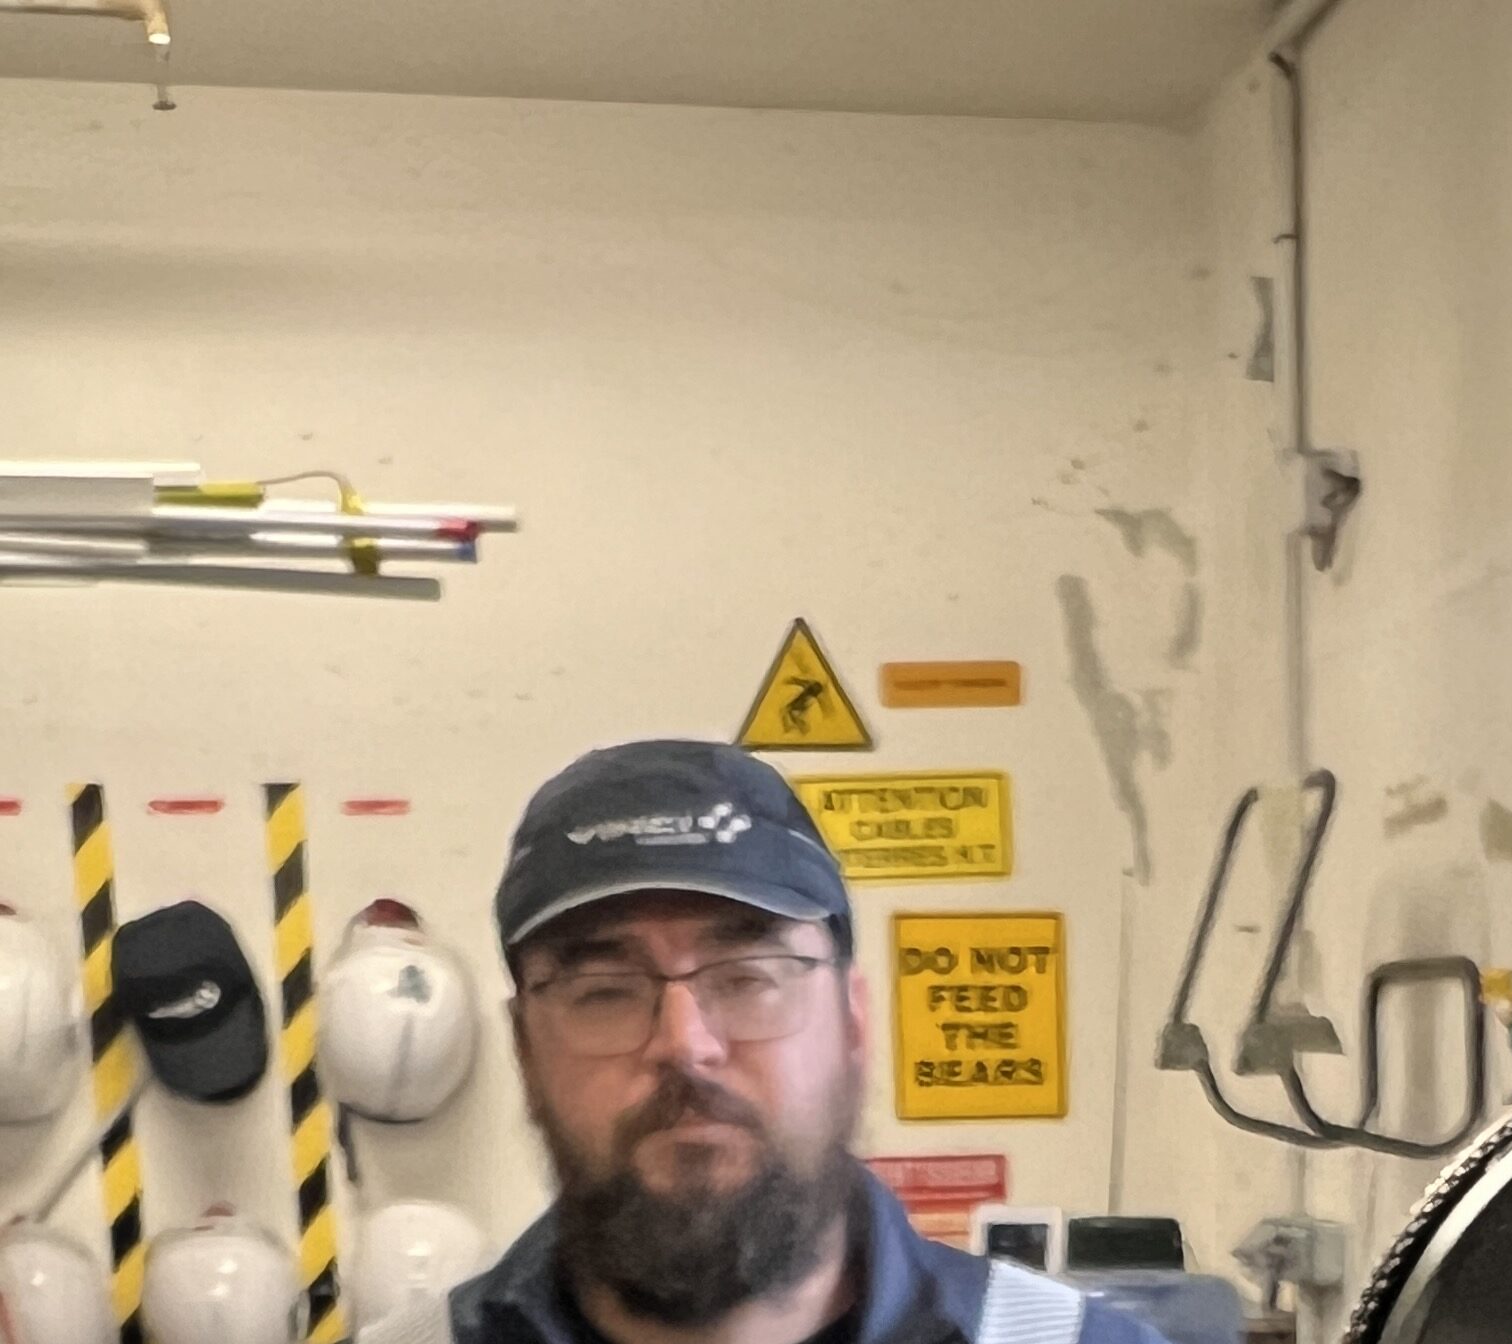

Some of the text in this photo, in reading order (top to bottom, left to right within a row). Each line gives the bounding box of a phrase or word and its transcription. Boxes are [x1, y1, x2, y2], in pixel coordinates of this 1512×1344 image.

[901, 946, 1051, 976] DO NOT
[927, 984, 1028, 1013] FEED
[939, 1022, 1019, 1051] THE
[914, 1057, 1044, 1087] BEARS
